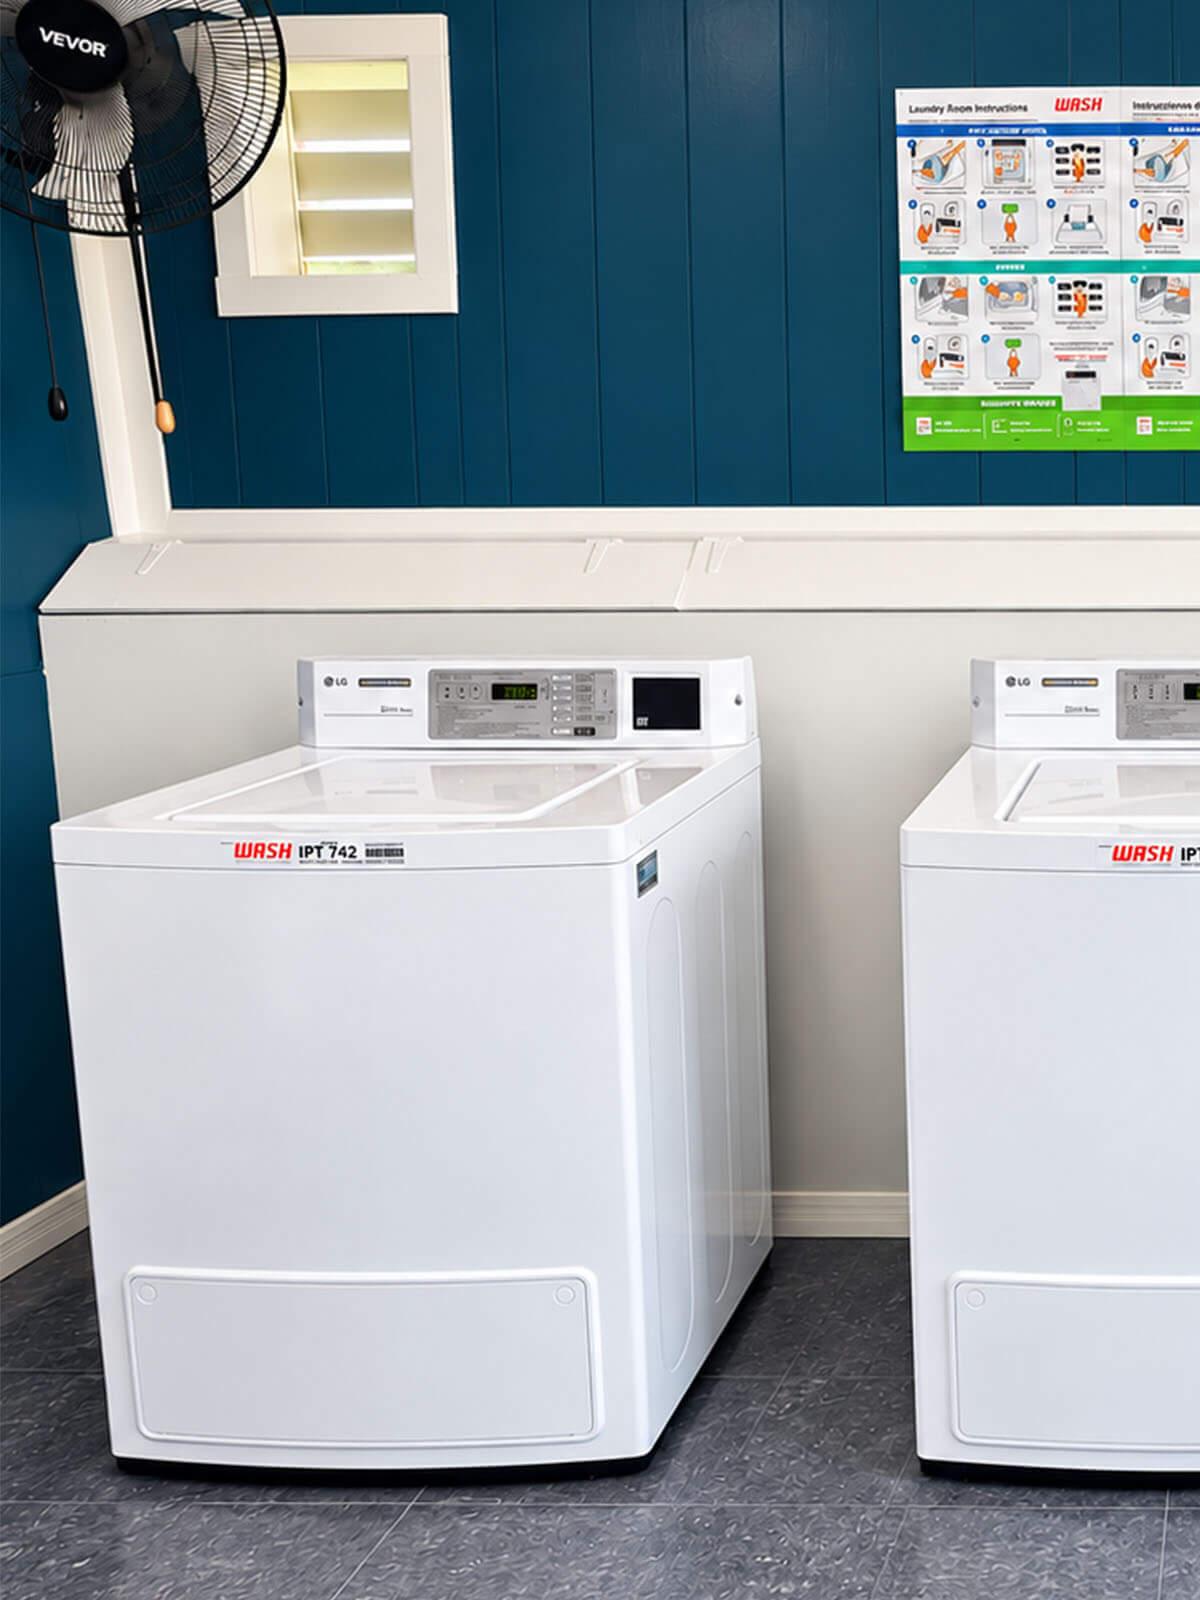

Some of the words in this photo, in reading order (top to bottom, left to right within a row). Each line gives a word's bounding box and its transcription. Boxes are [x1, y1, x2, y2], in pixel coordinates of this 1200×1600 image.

[38, 26, 107, 58] VEVOR
[908, 104, 944, 115] Laundry
[975, 103, 1029, 113] Instructions
[1054, 97, 1103, 112] WASH
[335, 678, 348, 687] LG
[1017, 677, 1031, 687] LG
[234, 842, 292, 859] WASH
[298, 845, 322, 858] IPT
[329, 845, 358, 858] 742
[1112, 845, 1174, 862] WASH
